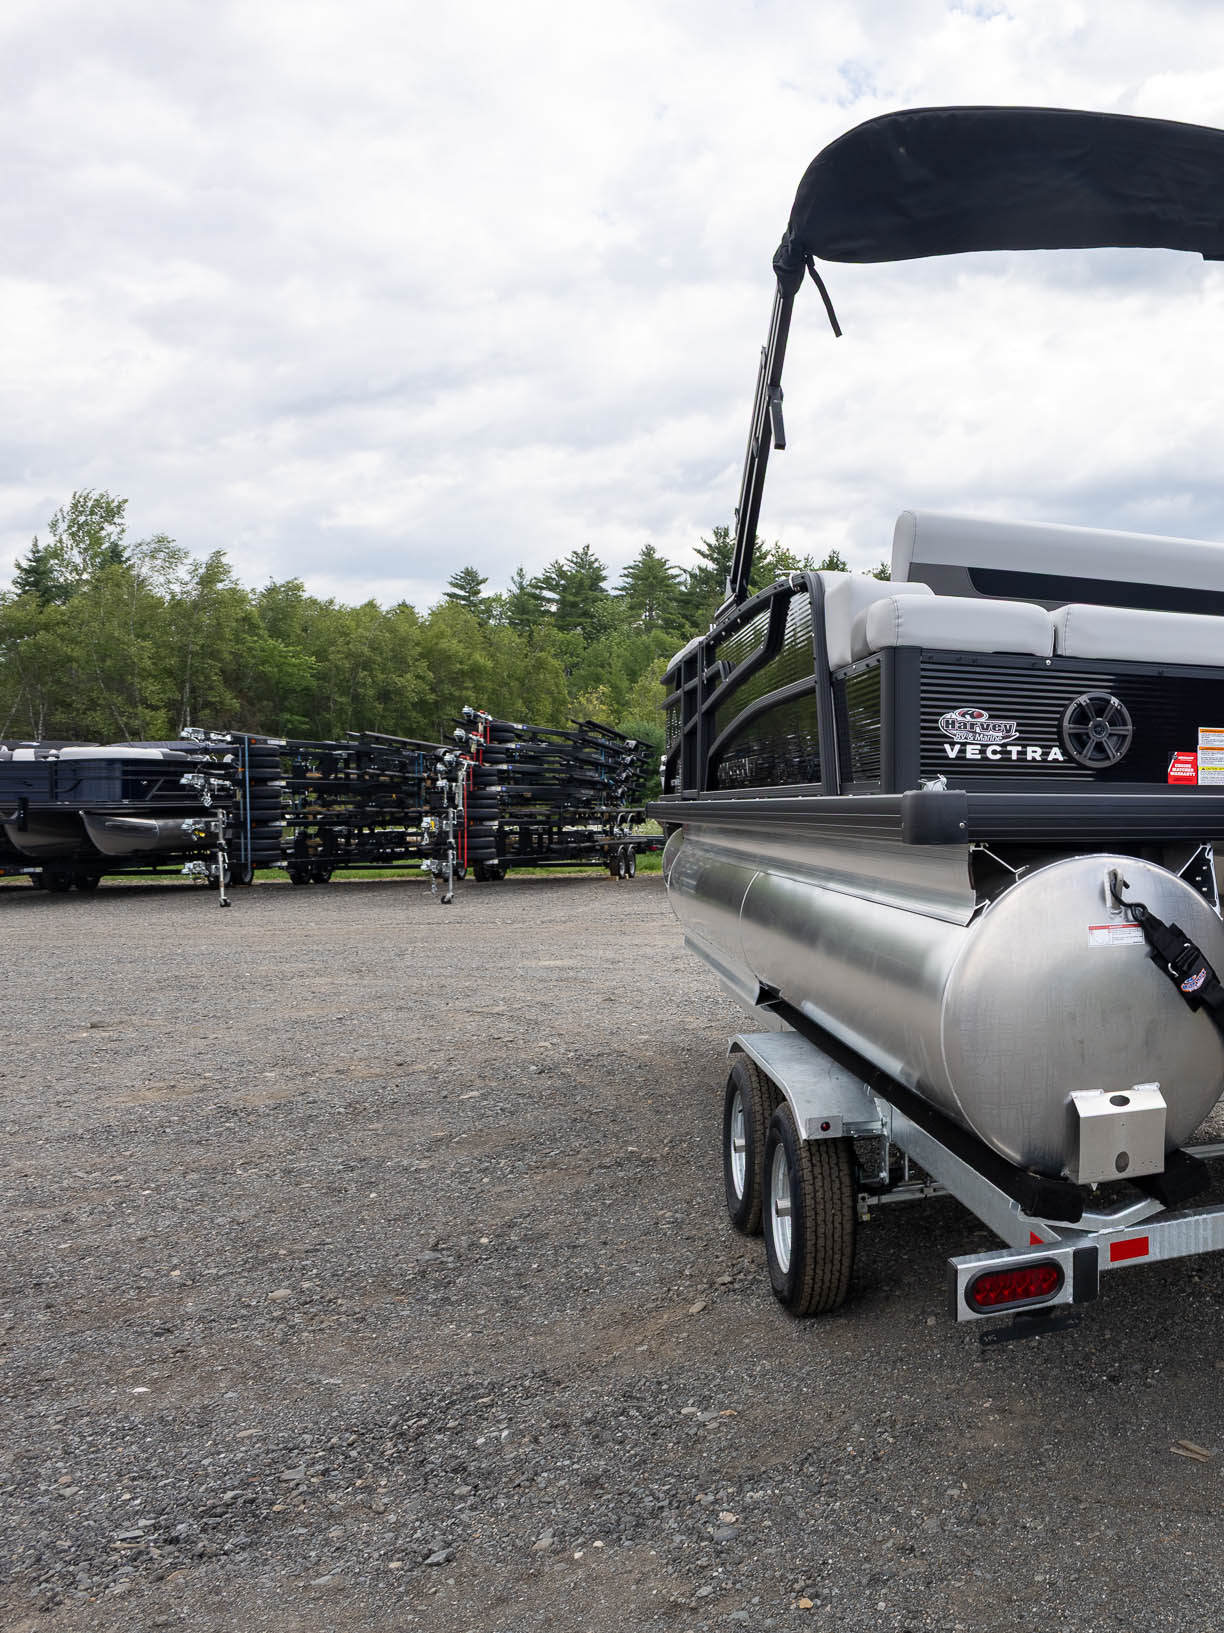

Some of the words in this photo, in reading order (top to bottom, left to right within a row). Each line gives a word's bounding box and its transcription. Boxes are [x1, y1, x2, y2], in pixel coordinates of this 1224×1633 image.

[944, 719, 1014, 735] Harvey
[955, 732, 967, 741] RV
[975, 733, 1003, 742] Marine
[944, 744, 1064, 761] VECTRA
